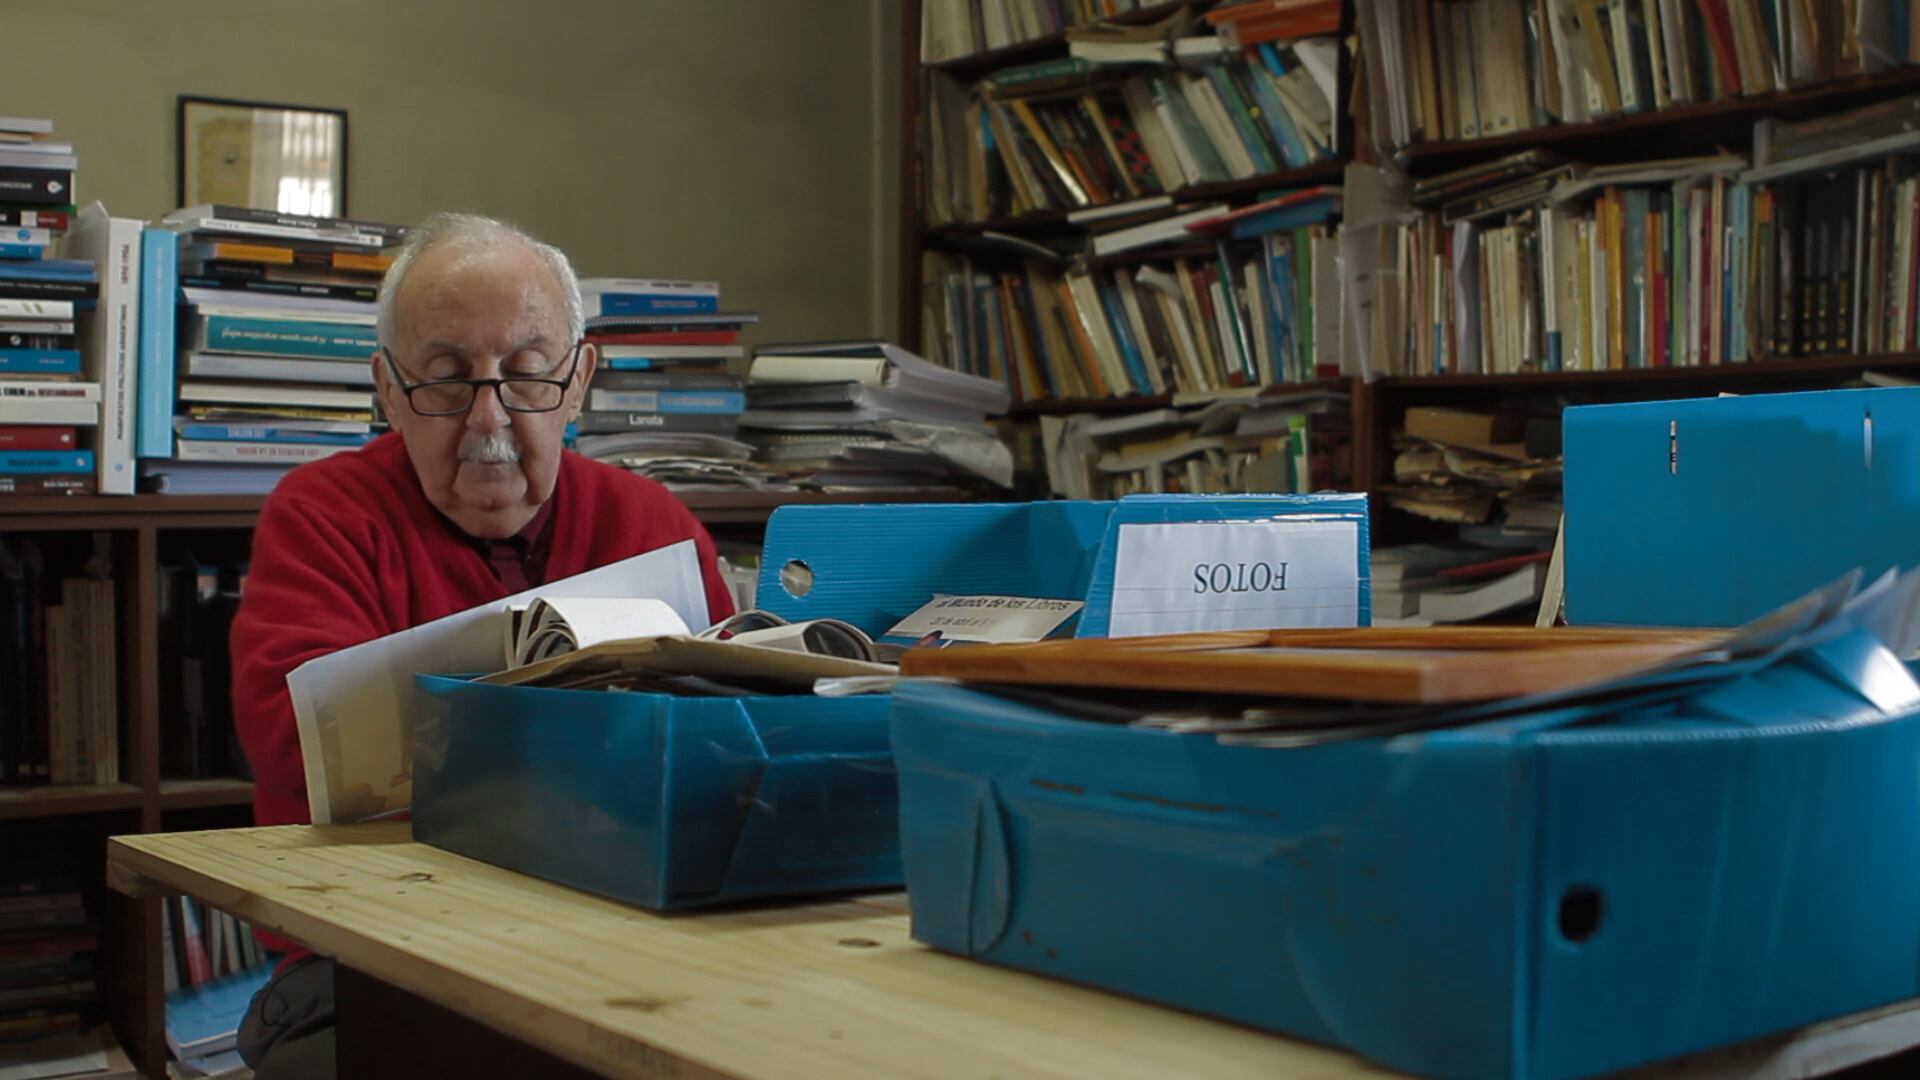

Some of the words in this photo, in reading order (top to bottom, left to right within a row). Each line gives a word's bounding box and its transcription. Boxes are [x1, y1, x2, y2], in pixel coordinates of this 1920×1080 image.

[629, 413, 664, 426] Lanata
[1193, 561, 1289, 594] FOTOS
[950, 597, 988, 609] Mundo
[987, 597, 1003, 609] de
[1005, 599, 1027, 609] los
[1025, 598, 1072, 611] Libros
